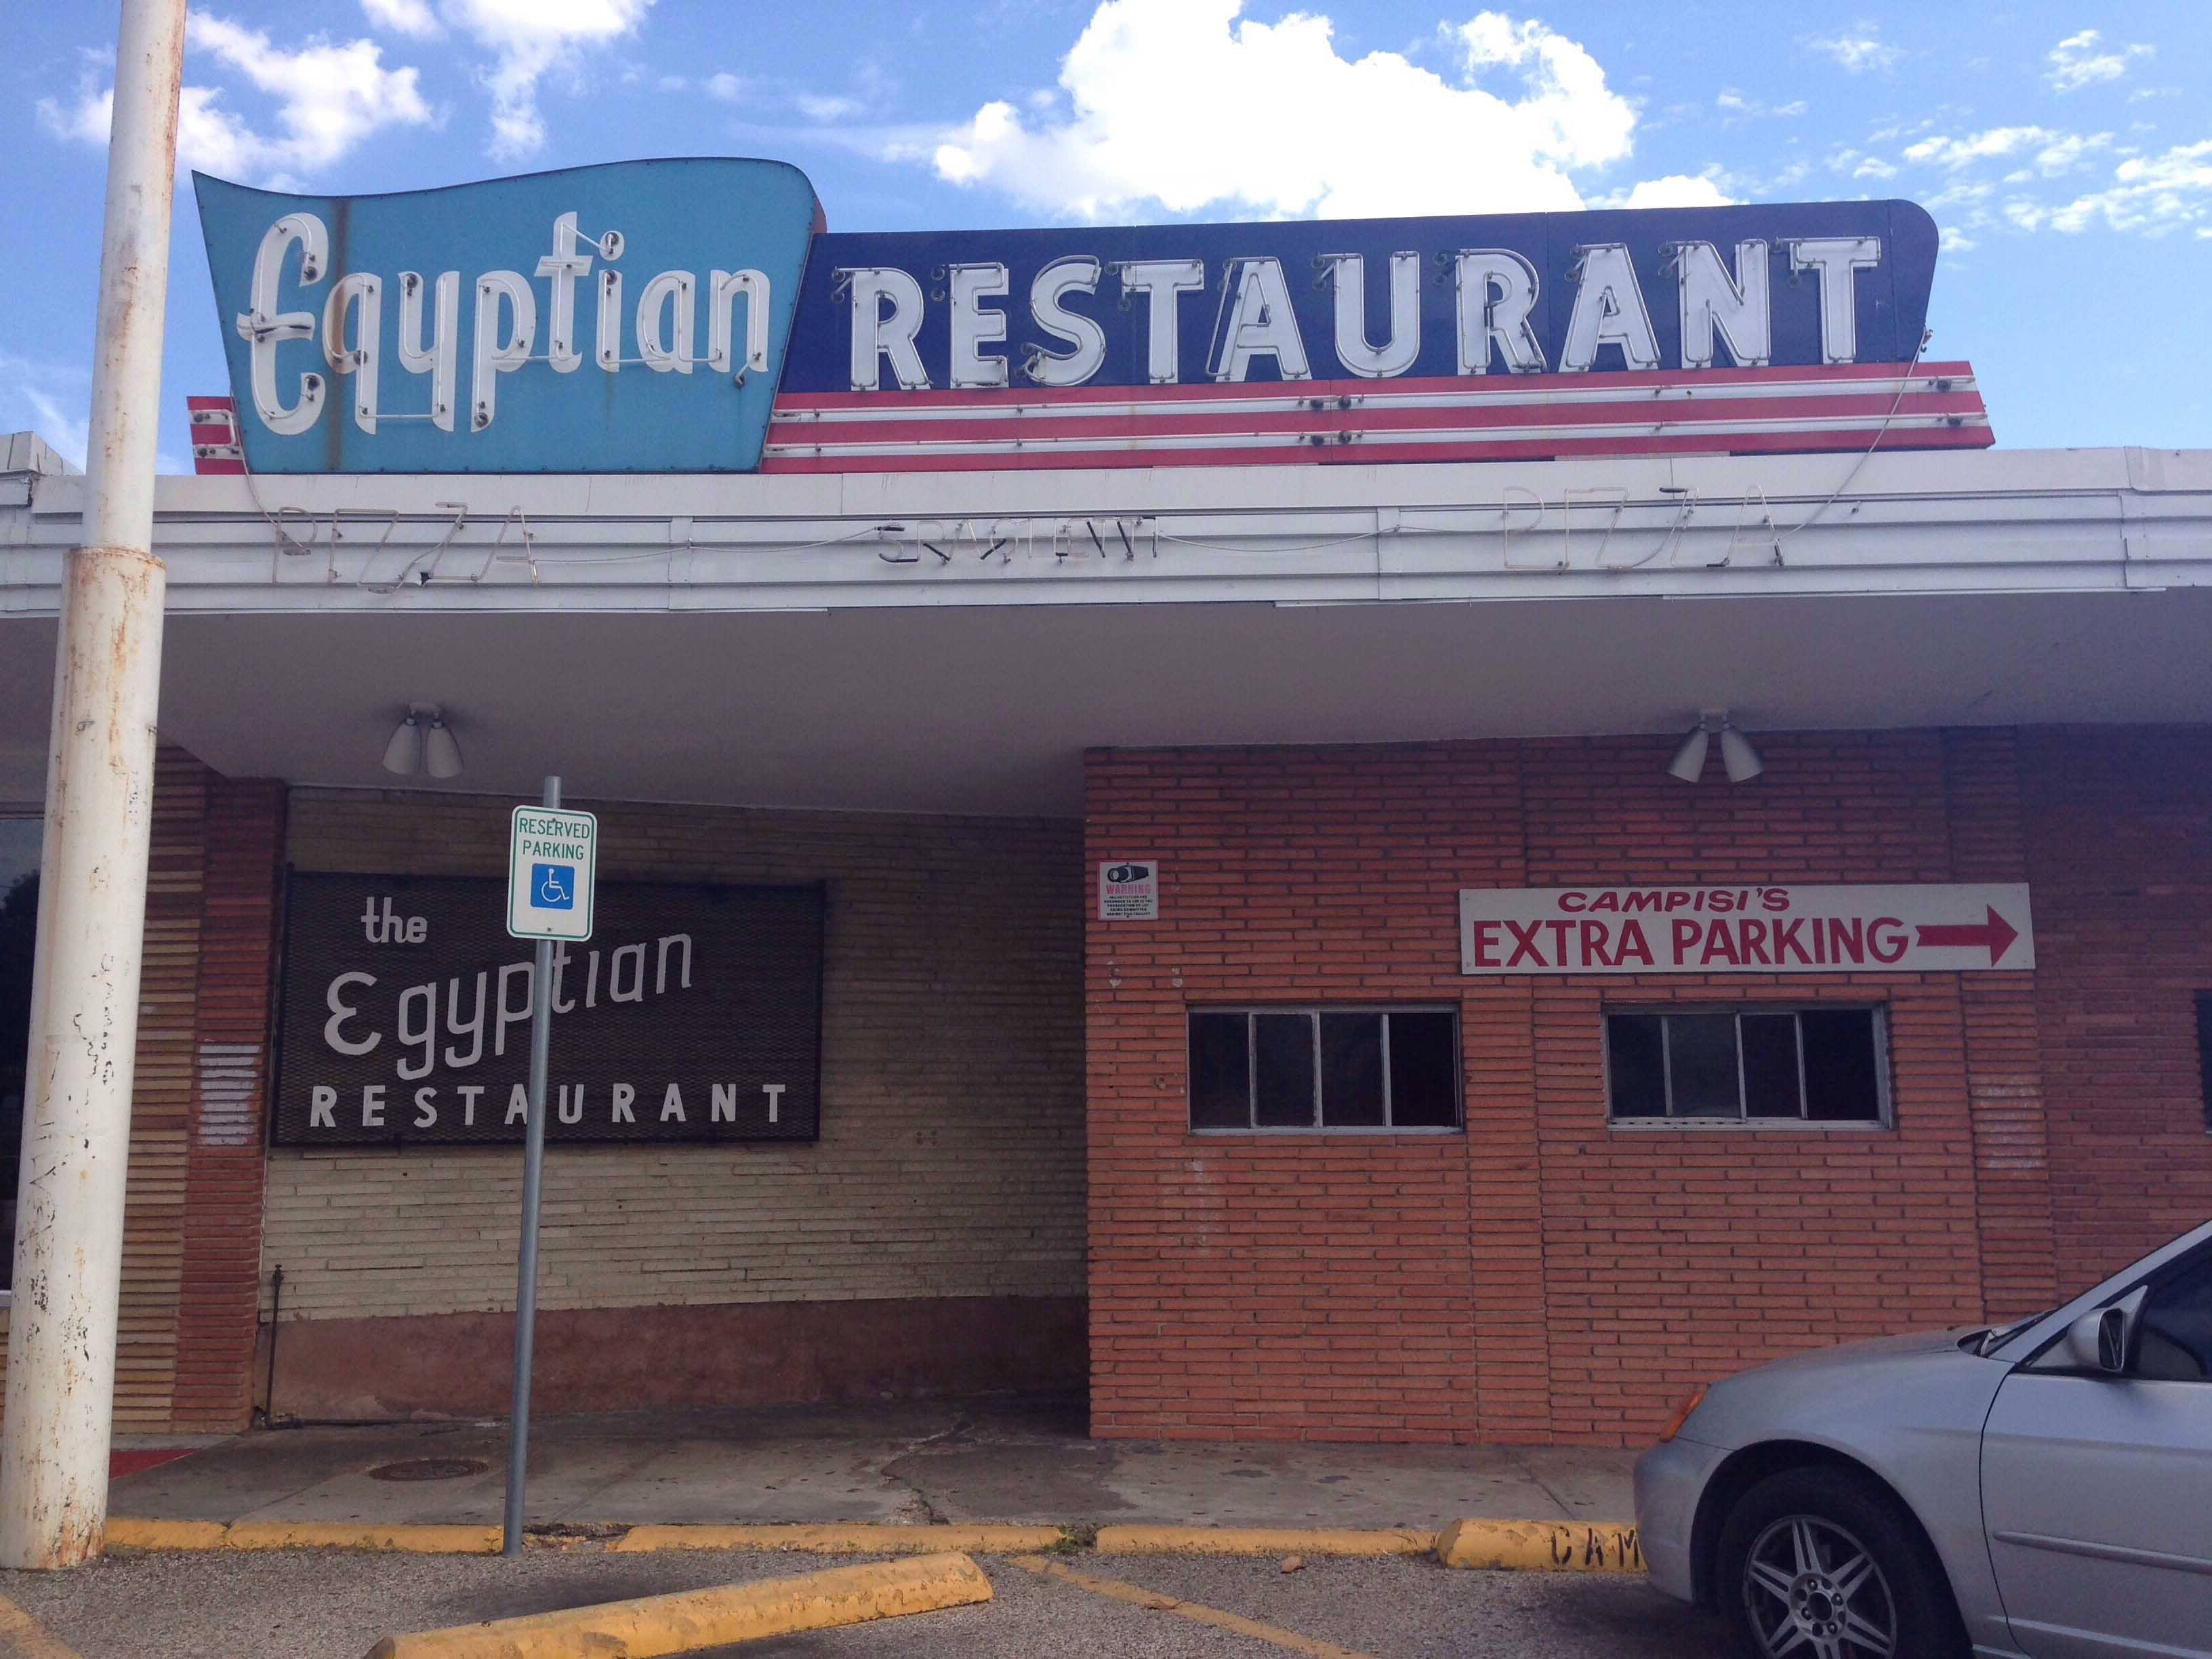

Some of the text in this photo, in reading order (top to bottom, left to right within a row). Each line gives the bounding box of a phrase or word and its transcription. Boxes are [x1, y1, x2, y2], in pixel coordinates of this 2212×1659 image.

[237, 211, 1881, 435] Egyptian RESTAURANT
[519, 817, 590, 839] RESERVED
[523, 840, 583, 860] PARKING
[1106, 884, 1150, 895] WARNING
[1557, 888, 1790, 913] CAMPISI'S
[361, 897, 428, 943] the
[1473, 918, 1909, 967] EXTRA PARKING
[324, 933, 691, 1080] Egyptian
[310, 1083, 785, 1128] RESTAURANT
